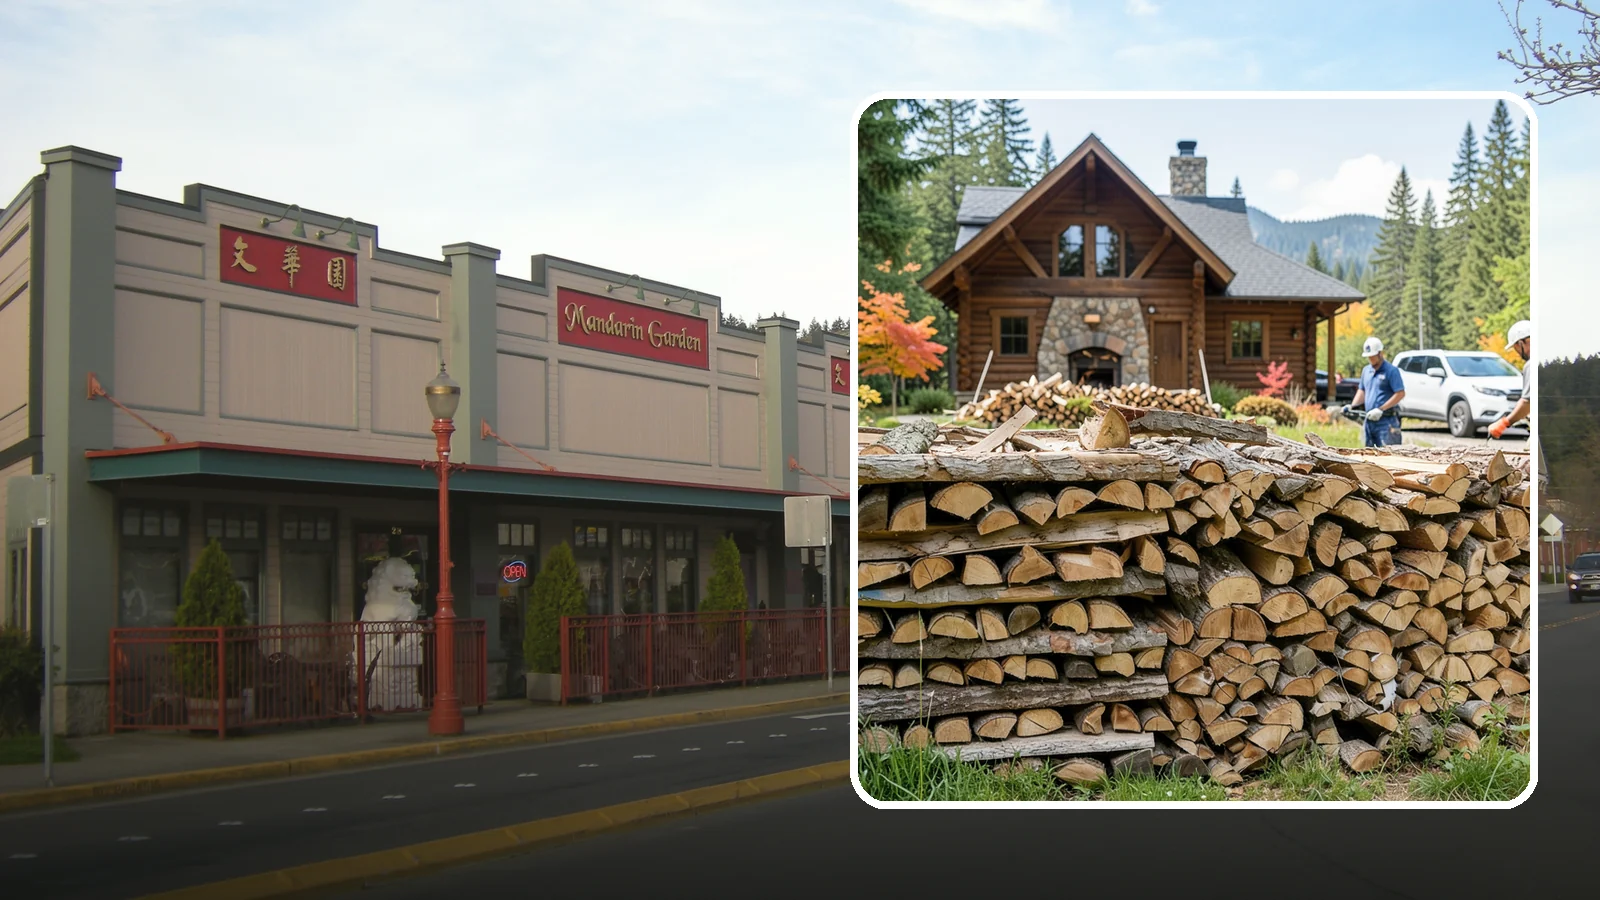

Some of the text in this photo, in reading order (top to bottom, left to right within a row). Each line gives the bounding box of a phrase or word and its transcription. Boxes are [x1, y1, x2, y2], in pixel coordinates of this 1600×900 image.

[231, 236, 346, 291] 文華園
[564, 302, 701, 352] Mandarin Garden
[503, 566, 527, 578] OPEN
